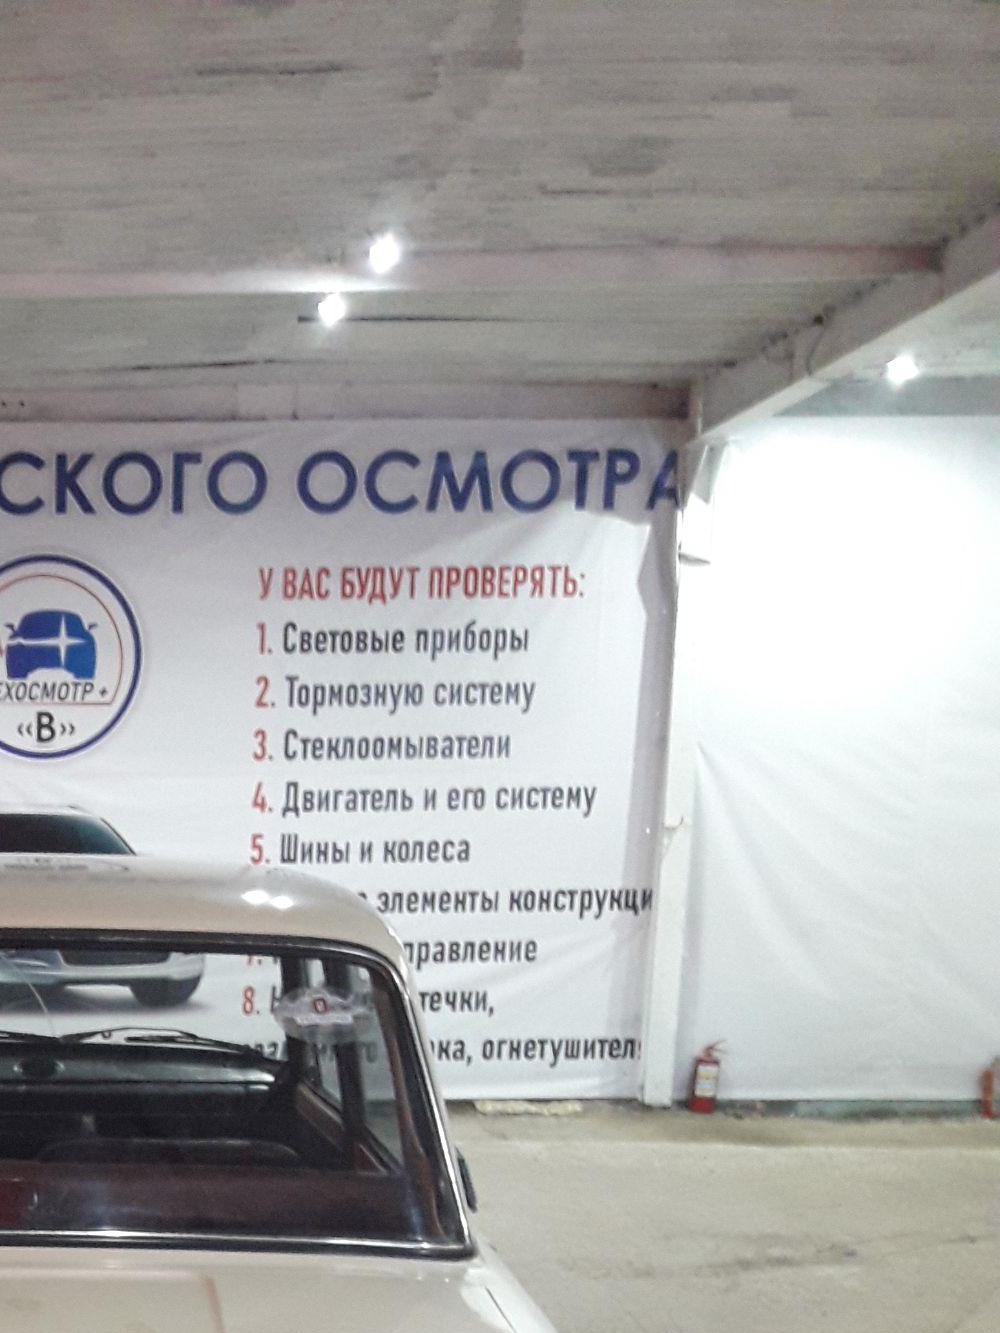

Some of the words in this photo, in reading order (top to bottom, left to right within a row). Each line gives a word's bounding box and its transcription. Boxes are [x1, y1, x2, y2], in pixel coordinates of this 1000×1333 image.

[297, 449, 679, 515] ОСМОТРА
[283, 567, 331, 600] ВАС
[340, 566, 420, 604] БУДУТ
[429, 564, 586, 599] ПРОВЕРЯТЬ:
[257, 622, 272, 655] 1.
[283, 621, 405, 654] Световые
[415, 620, 529, 662] приборы
[255, 676, 276, 708] 2.
[286, 675, 424, 714] Тормозную
[433, 680, 536, 714] систему
[253, 729, 273, 762] 3.
[284, 728, 511, 761] Стеклоомыватели
[252, 782, 272, 814] 4.
[282, 781, 414, 818] Двигатель
[424, 788, 437, 812] и
[447, 787, 486, 812] его
[495, 786, 597, 818] систему
[280, 833, 351, 865] Шины
[359, 840, 373, 864] и
[383, 838, 471, 864] колеса
[377, 891, 500, 915] элементы
[509, 886, 653, 920] конструкци
[401, 938, 539, 971] правление
